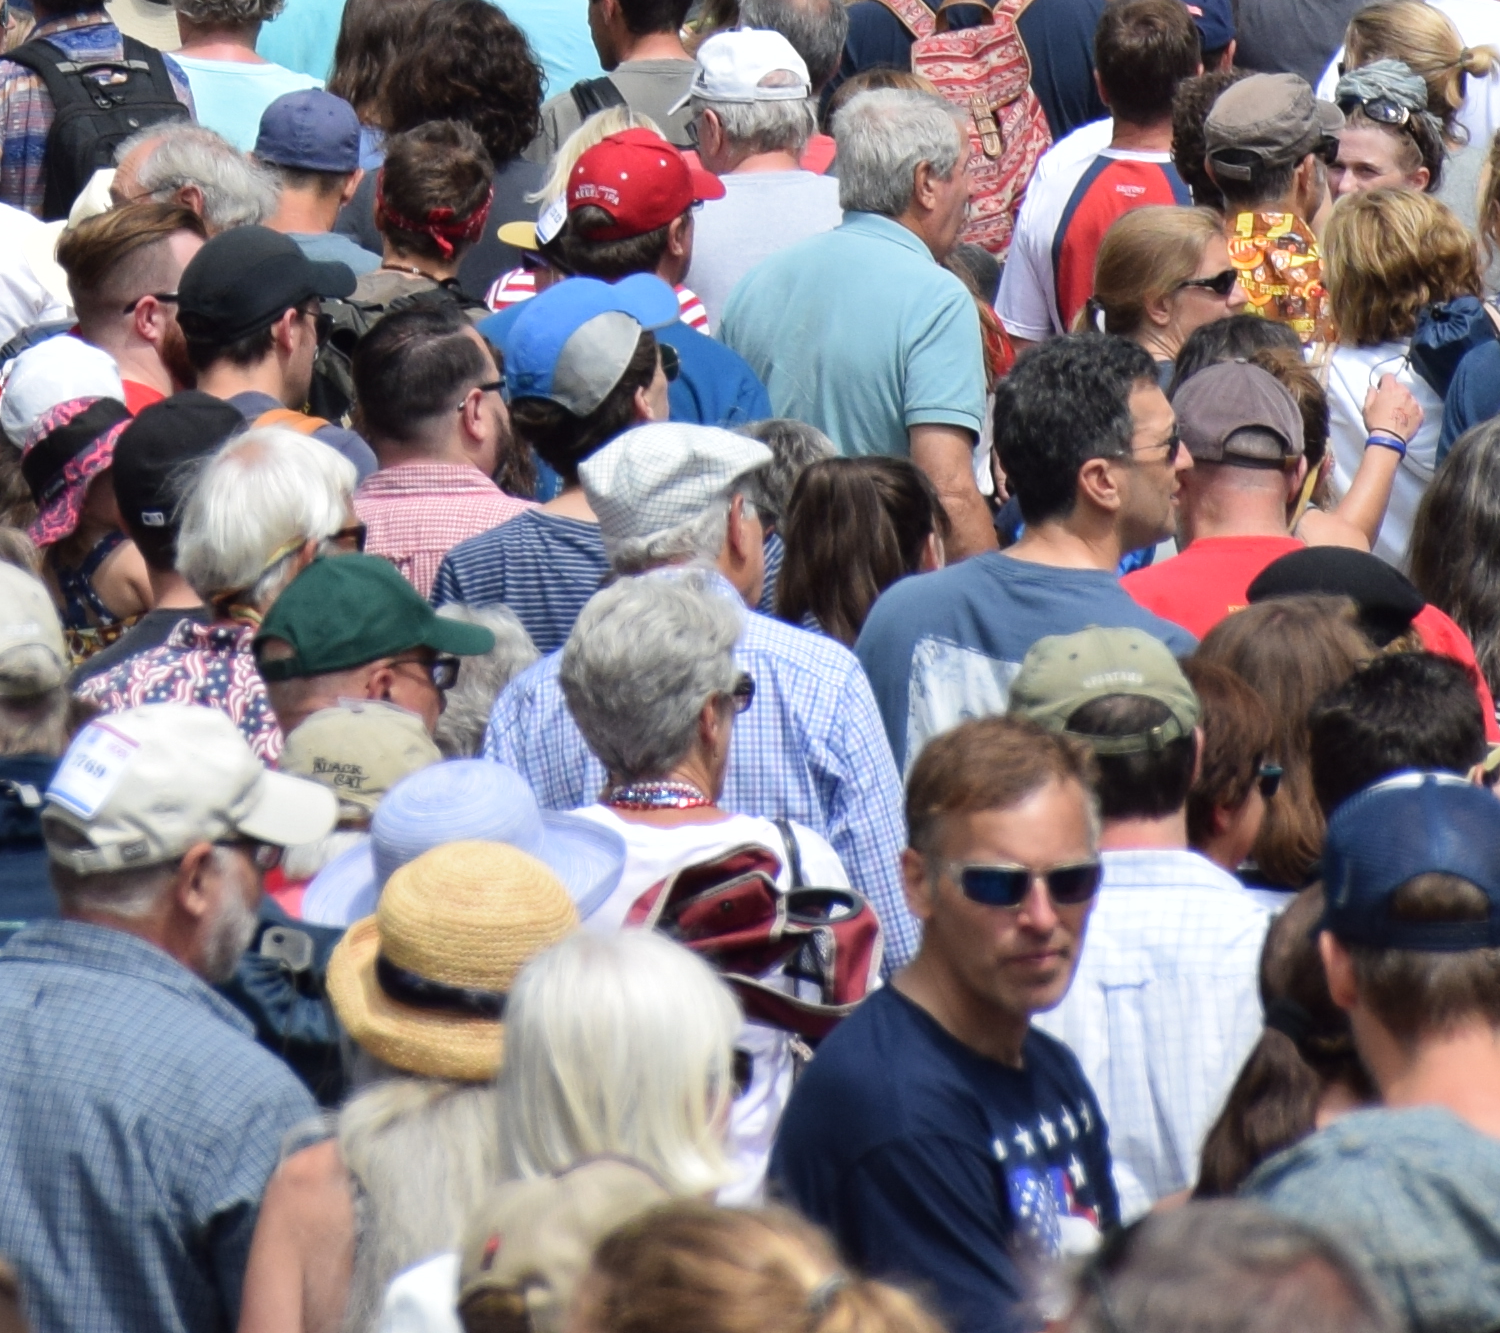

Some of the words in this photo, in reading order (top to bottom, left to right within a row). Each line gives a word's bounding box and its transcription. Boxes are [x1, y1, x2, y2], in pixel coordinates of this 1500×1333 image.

[1082, 670, 1145, 689] SPARTANS
[313, 757, 363, 774] BLACK
[333, 772, 369, 789] CAT
